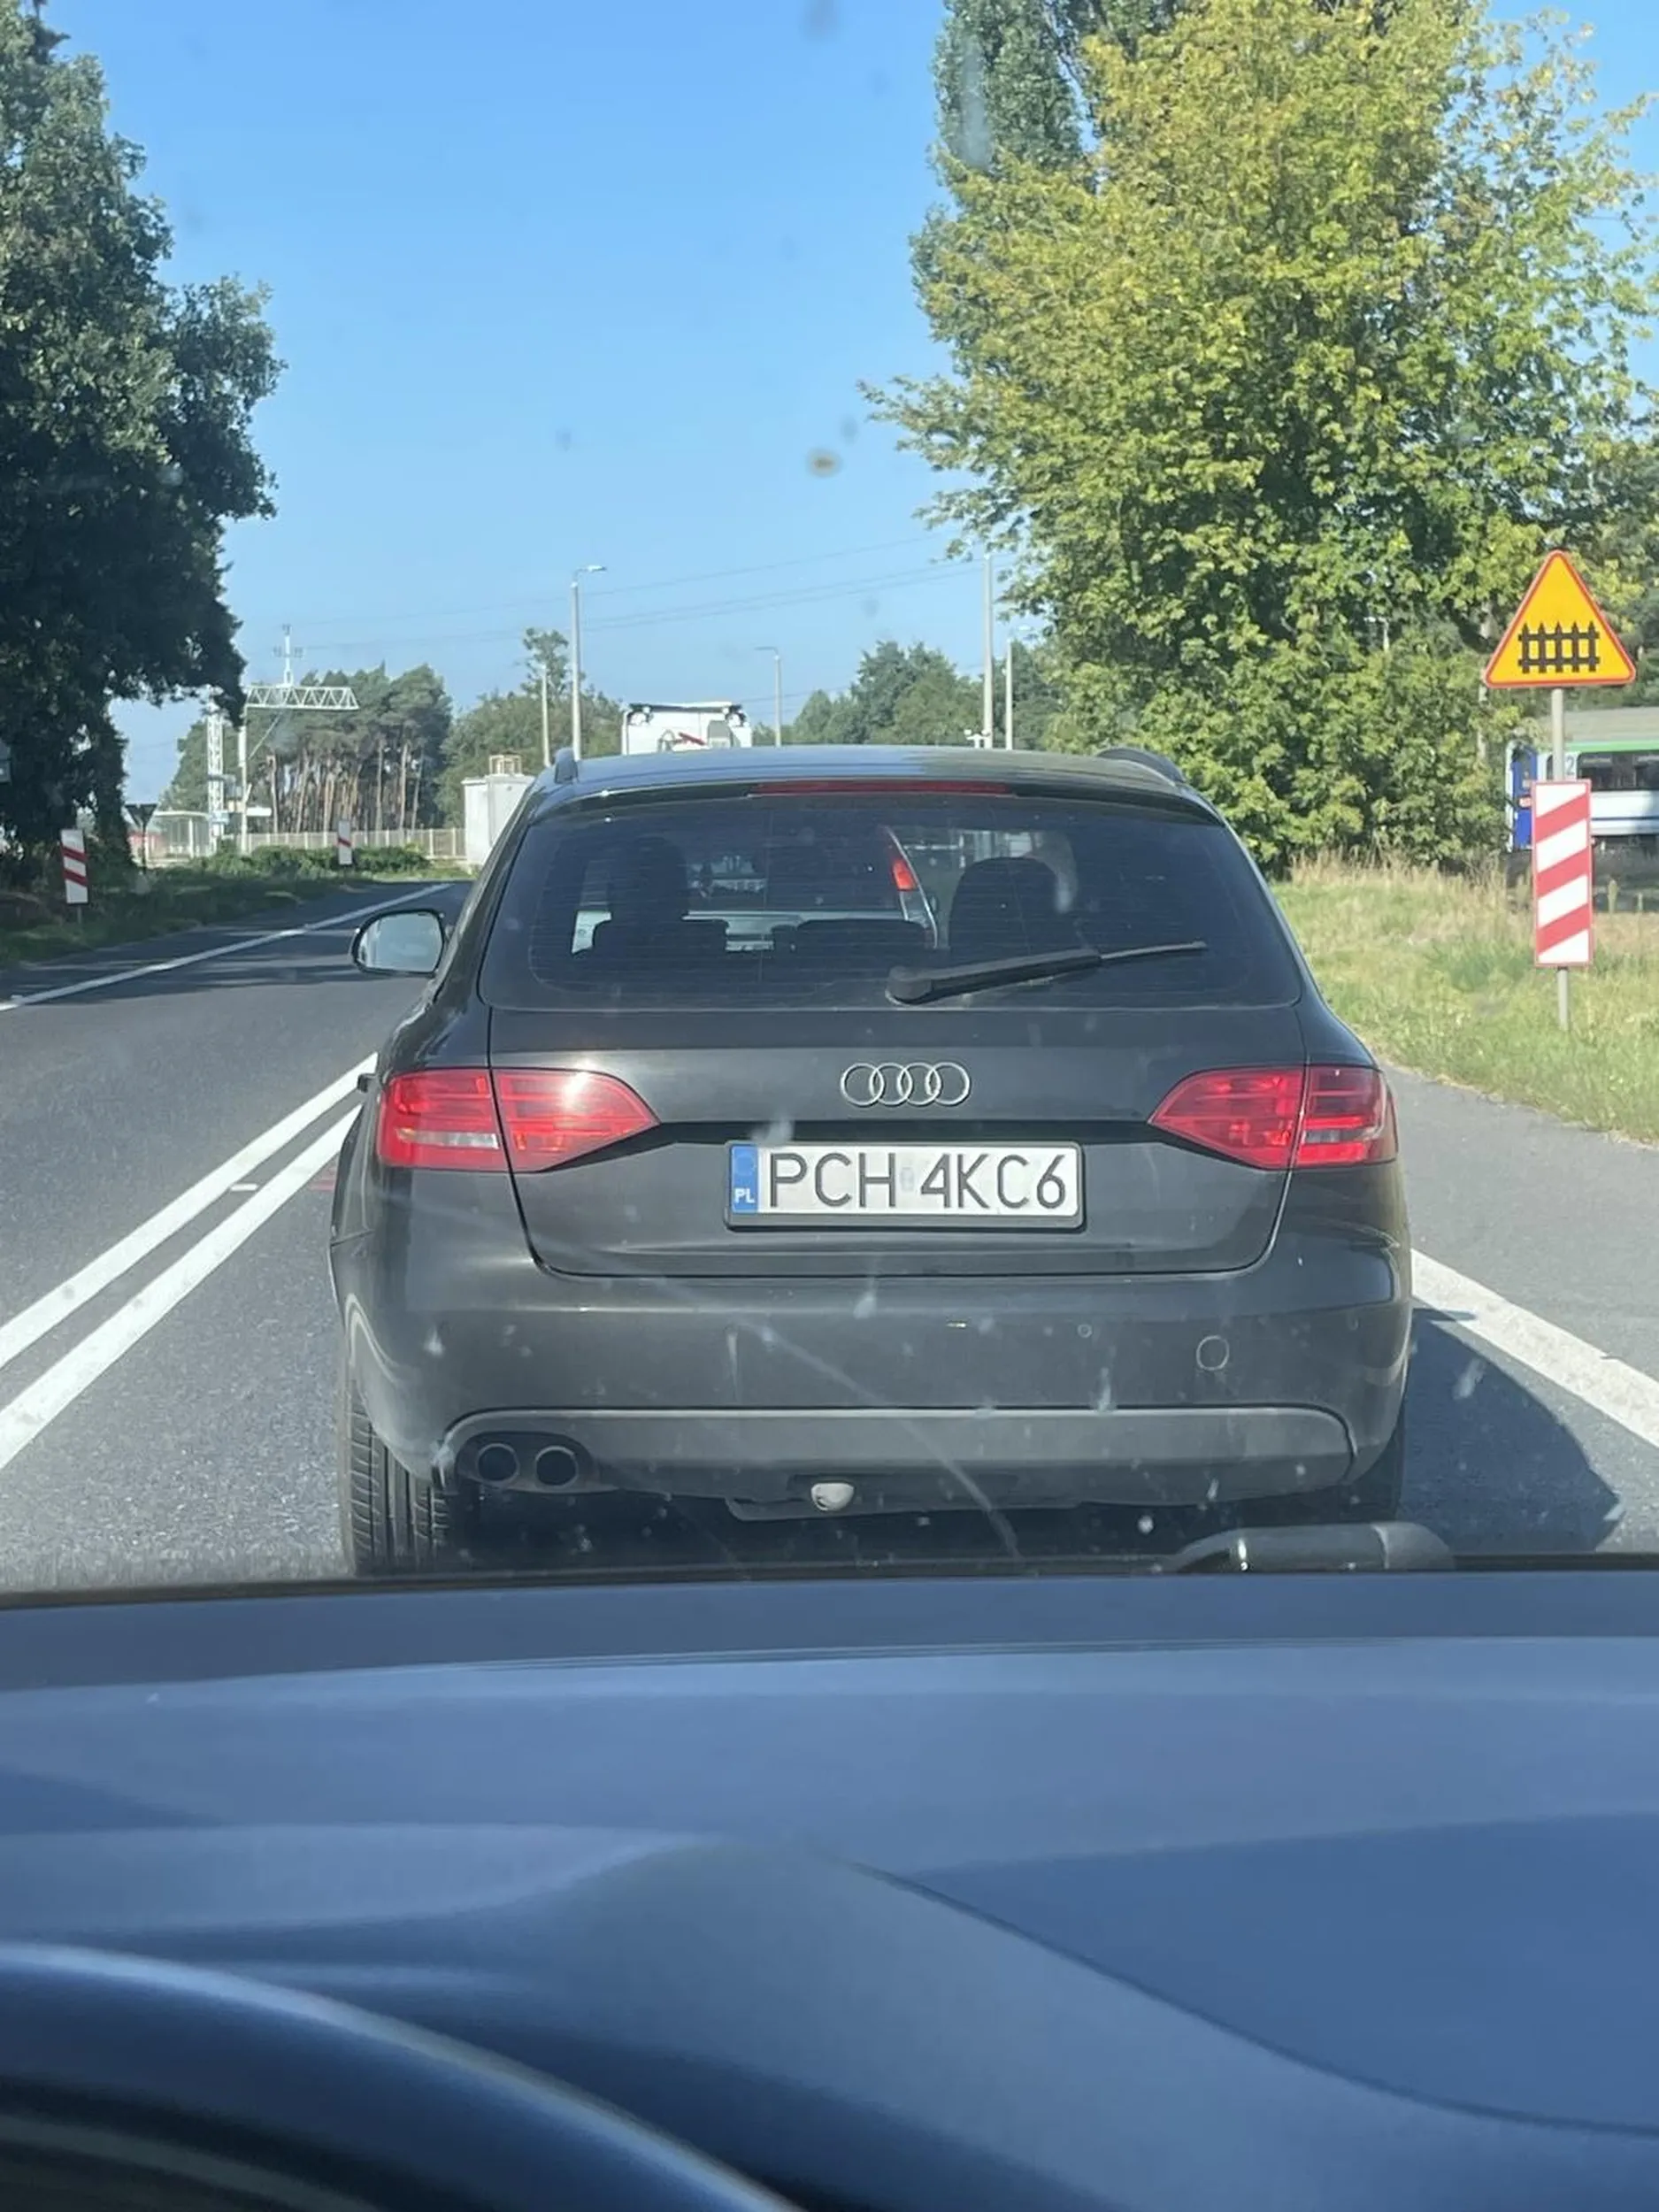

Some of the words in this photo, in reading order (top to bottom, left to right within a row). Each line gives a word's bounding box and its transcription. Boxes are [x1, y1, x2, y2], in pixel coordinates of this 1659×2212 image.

[1566, 756, 1575, 776] 2
[770, 1152, 896, 1209] PCH
[921, 1154, 1066, 1210] 4KC6
[735, 1188, 756, 1203] PL
